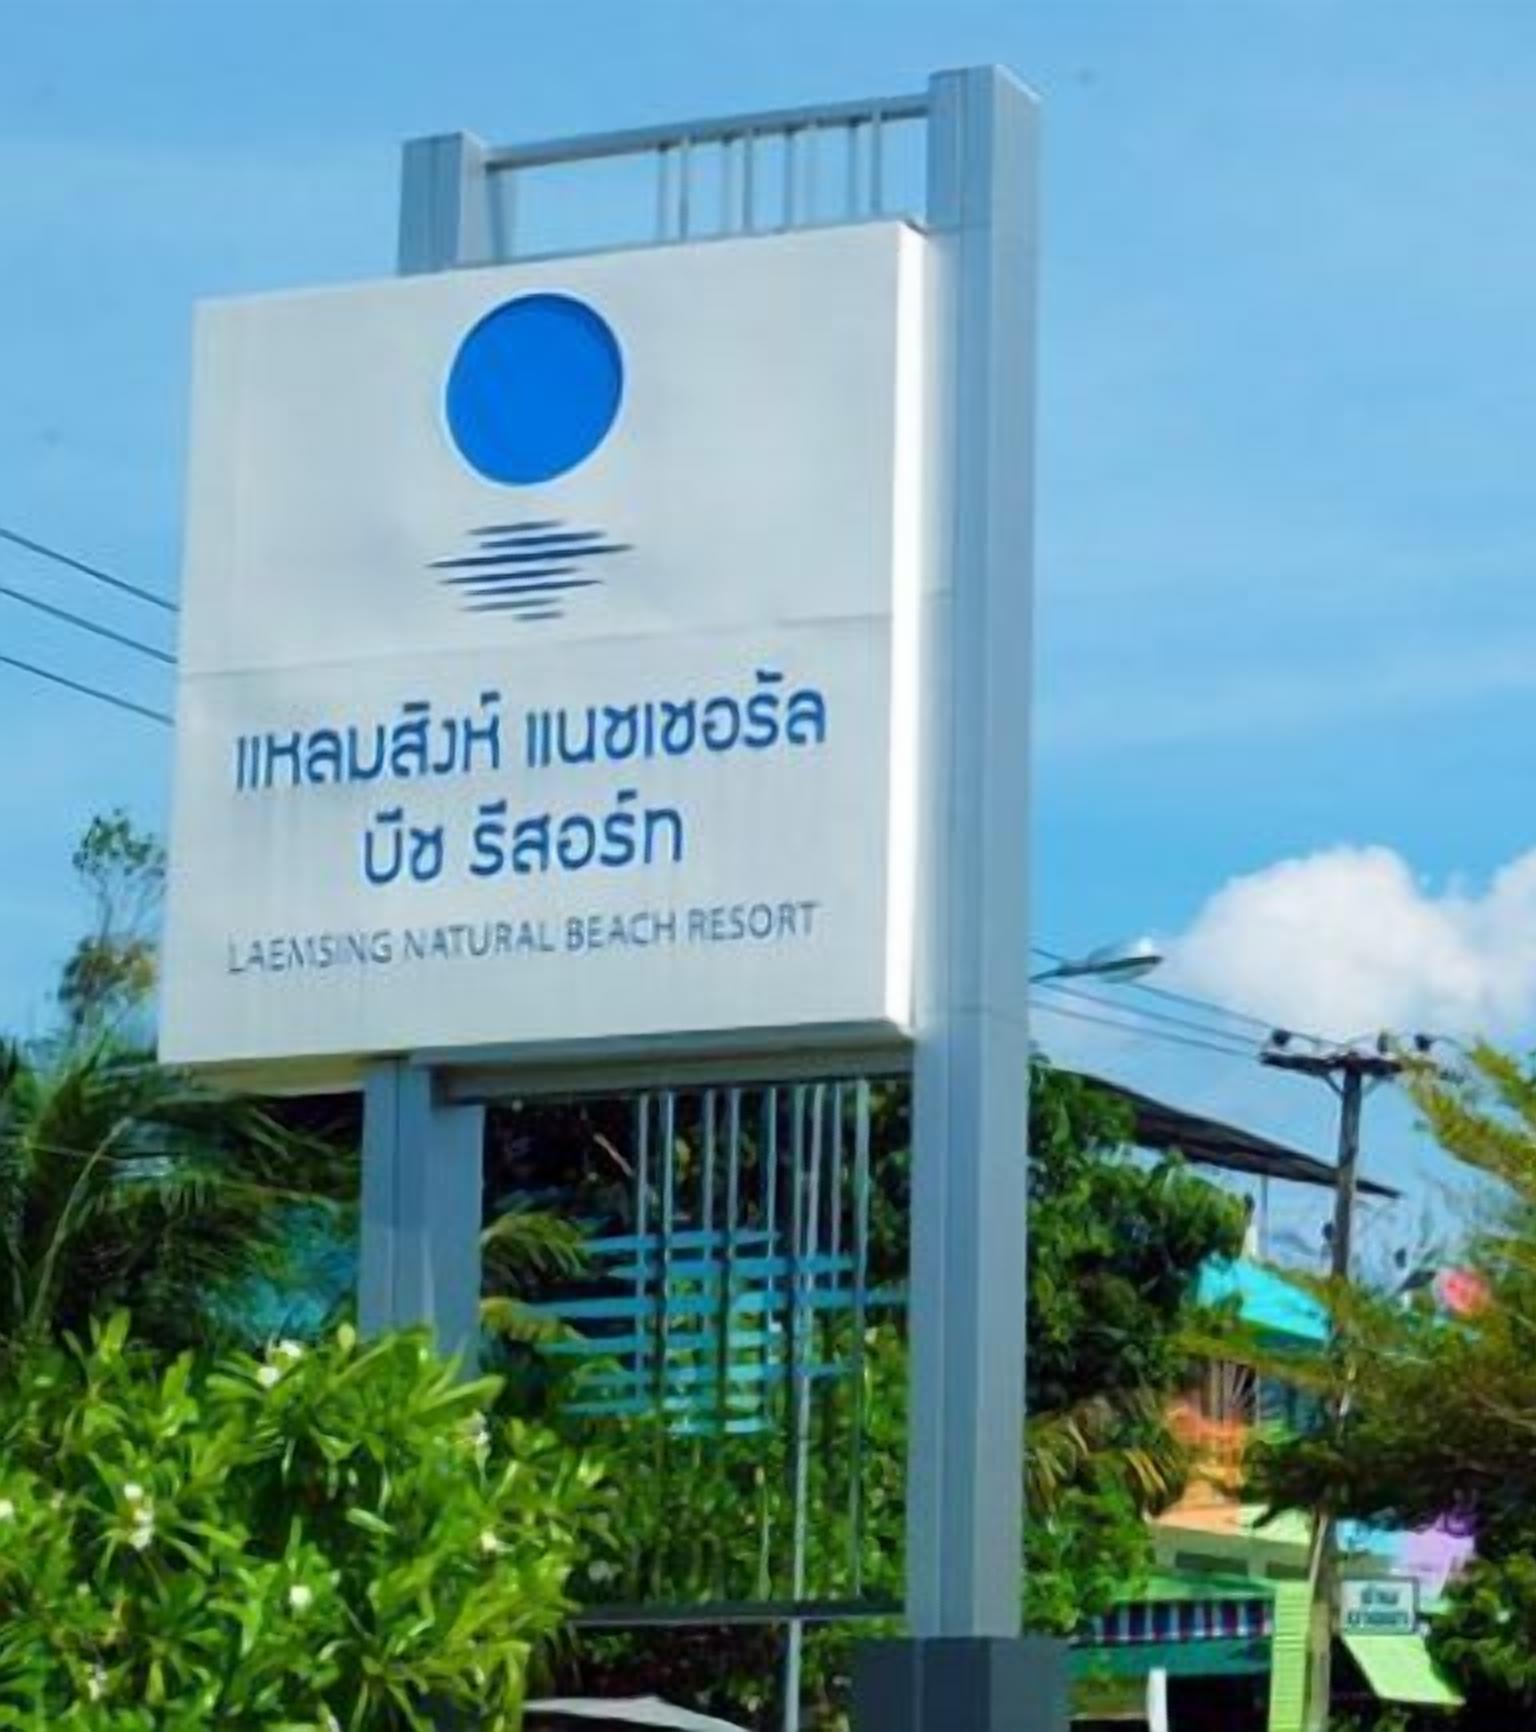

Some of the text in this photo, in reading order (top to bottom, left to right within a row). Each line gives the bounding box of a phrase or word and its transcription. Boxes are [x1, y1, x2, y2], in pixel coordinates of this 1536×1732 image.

[235, 689, 502, 792] แหลมสิงห์
[468, 787, 685, 880] รีสอร์ท
[228, 900, 820, 975] LAEMSING NATURAL BEACH RESORT
